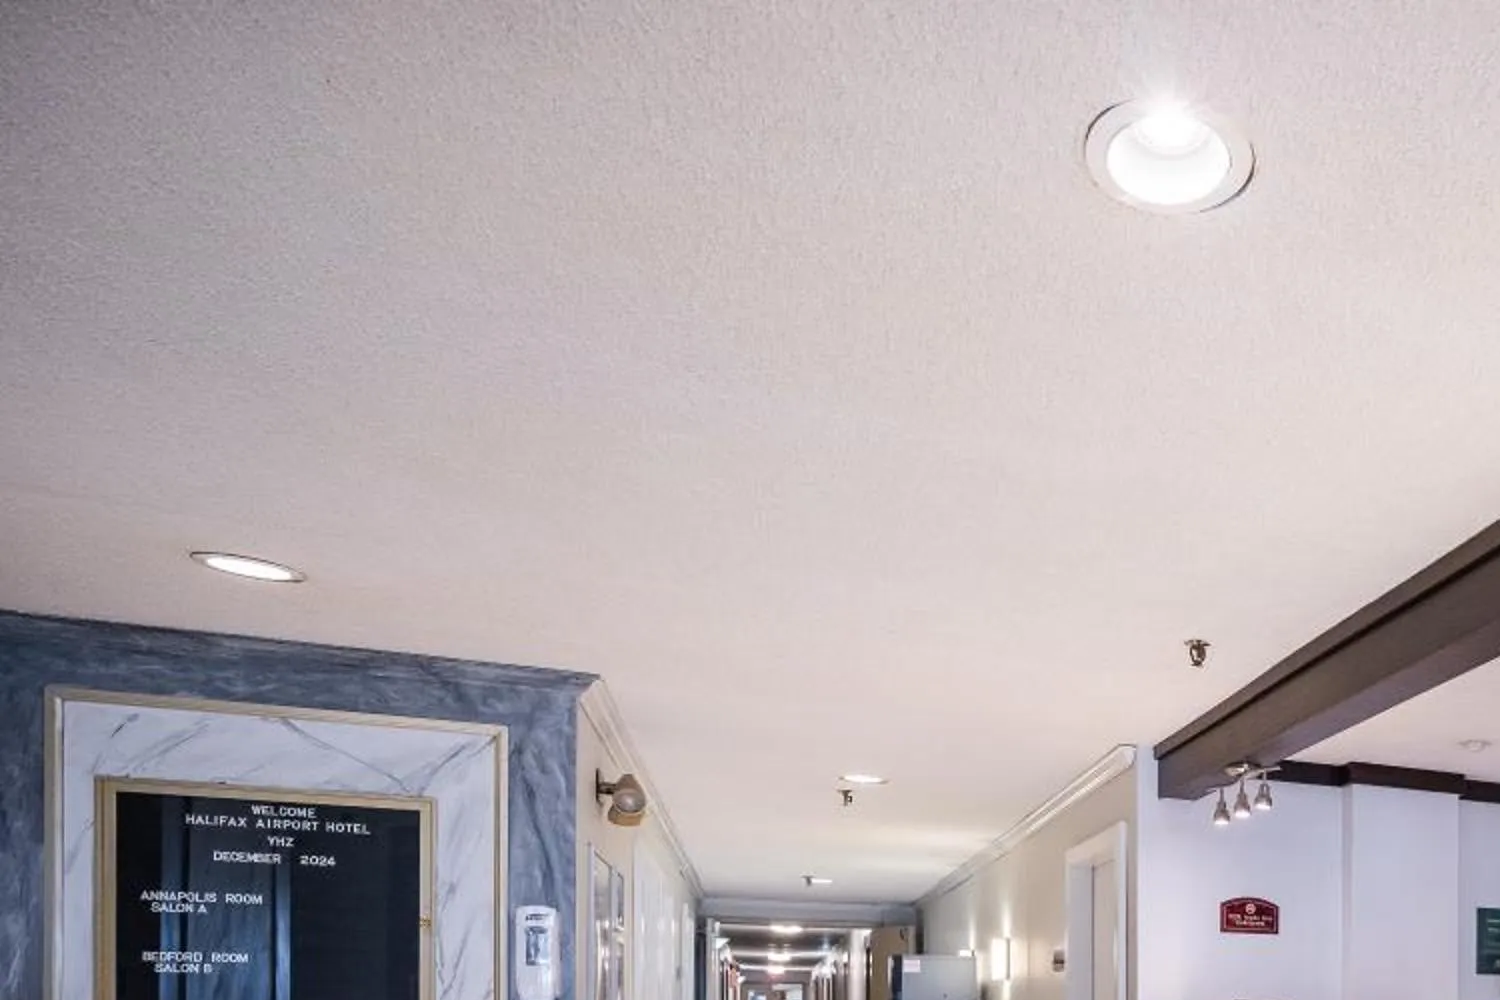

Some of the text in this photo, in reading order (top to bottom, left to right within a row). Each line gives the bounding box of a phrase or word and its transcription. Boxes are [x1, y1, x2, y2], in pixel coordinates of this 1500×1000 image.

[251, 804, 317, 819] WELCOME
[185, 813, 372, 835] HALIFAX AIRPORT HOTEL
[267, 835, 296, 848] YHZ
[213, 850, 337, 867] DECEMBER 2024
[140, 890, 263, 905] ANNAPOLIS ROOM
[151, 902, 208, 913] SALON A
[142, 951, 249, 963] BEDFORD ROOM
[154, 963, 213, 974] SALON B
